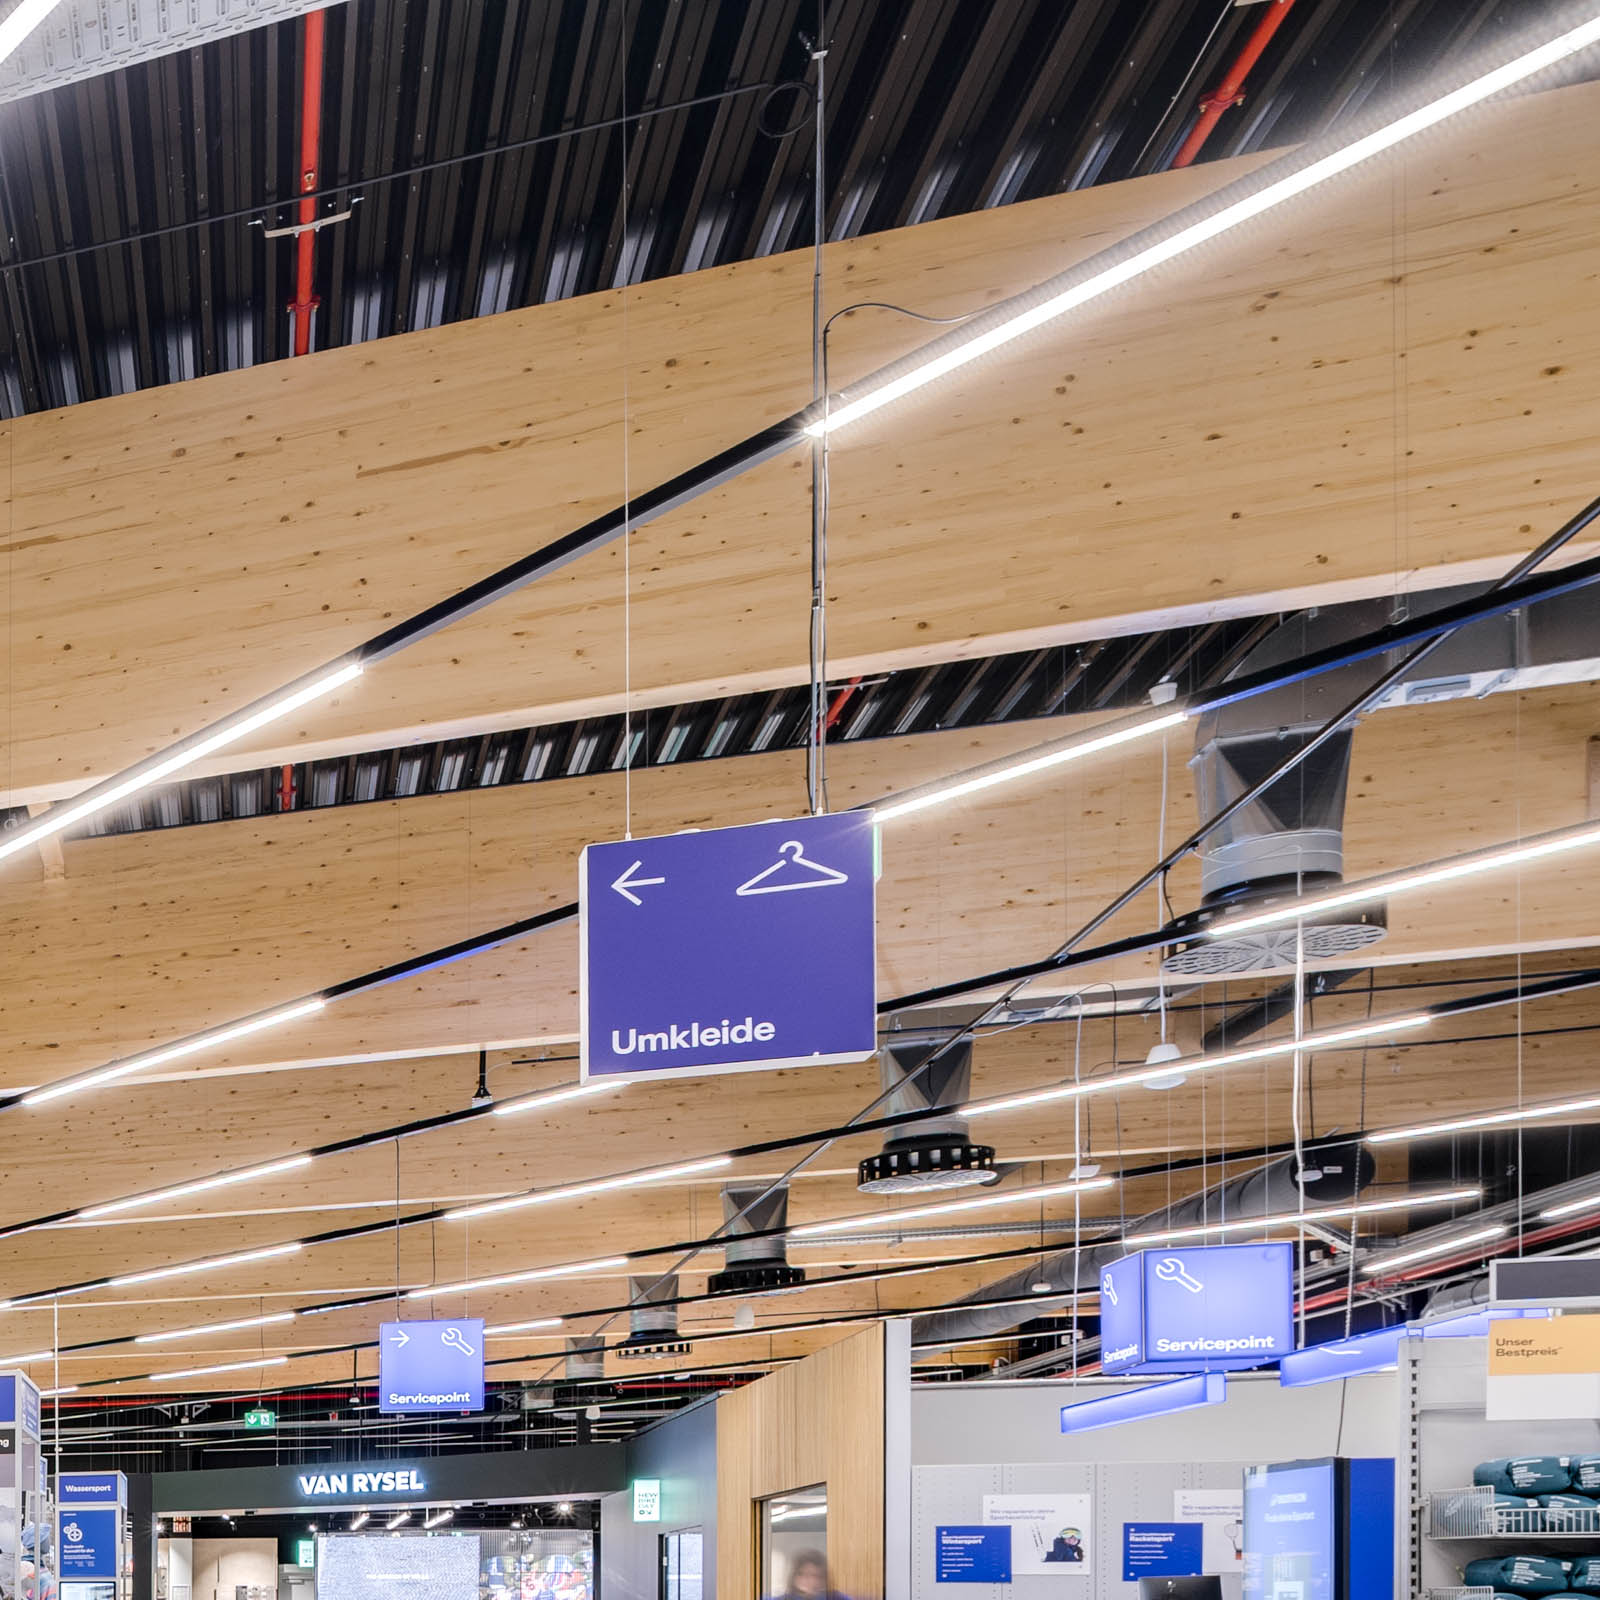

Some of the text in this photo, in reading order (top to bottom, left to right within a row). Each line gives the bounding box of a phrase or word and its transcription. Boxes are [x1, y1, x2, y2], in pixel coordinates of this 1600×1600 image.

[612, 1017, 776, 1055] Umkleide
[1156, 1335, 1275, 1352] Servicepoint
[1496, 1337, 1534, 1346] Unser
[1496, 1346, 1558, 1357] Bestpreis
[389, 1392, 470, 1406] Servicepoint
[65, 1484, 112, 1493] Wassersport
[300, 1470, 425, 1495] VAN RYSEL
